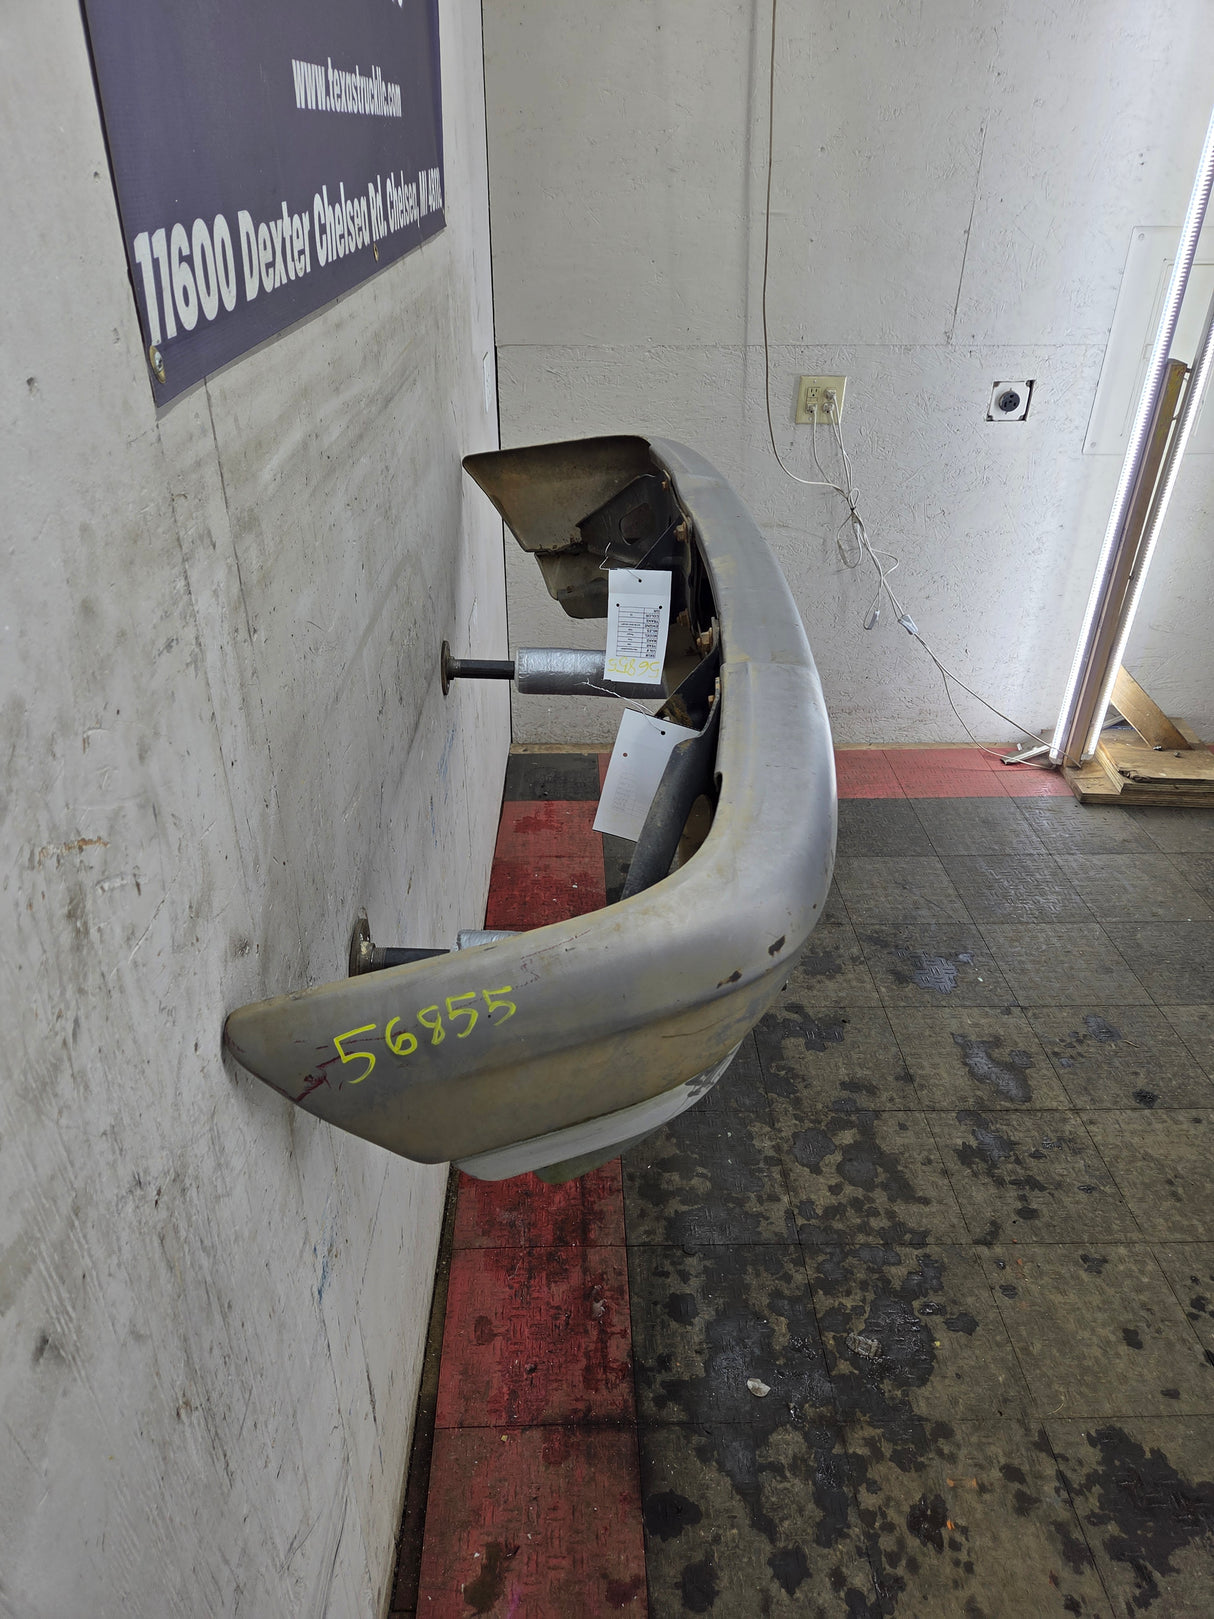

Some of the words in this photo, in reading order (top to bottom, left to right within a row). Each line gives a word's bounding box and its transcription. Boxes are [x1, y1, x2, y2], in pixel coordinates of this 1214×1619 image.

[291, 57, 402, 117] www.texastruckllc.com
[133, 214, 237, 347] 11600
[237, 200, 312, 302] Dexter
[313, 181, 371, 268] Chelsea
[367, 174, 388, 242] Rd.
[386, 169, 420, 233] Chelsea,
[607, 656, 660, 678] 56855
[333, 985, 517, 1084] 56855
